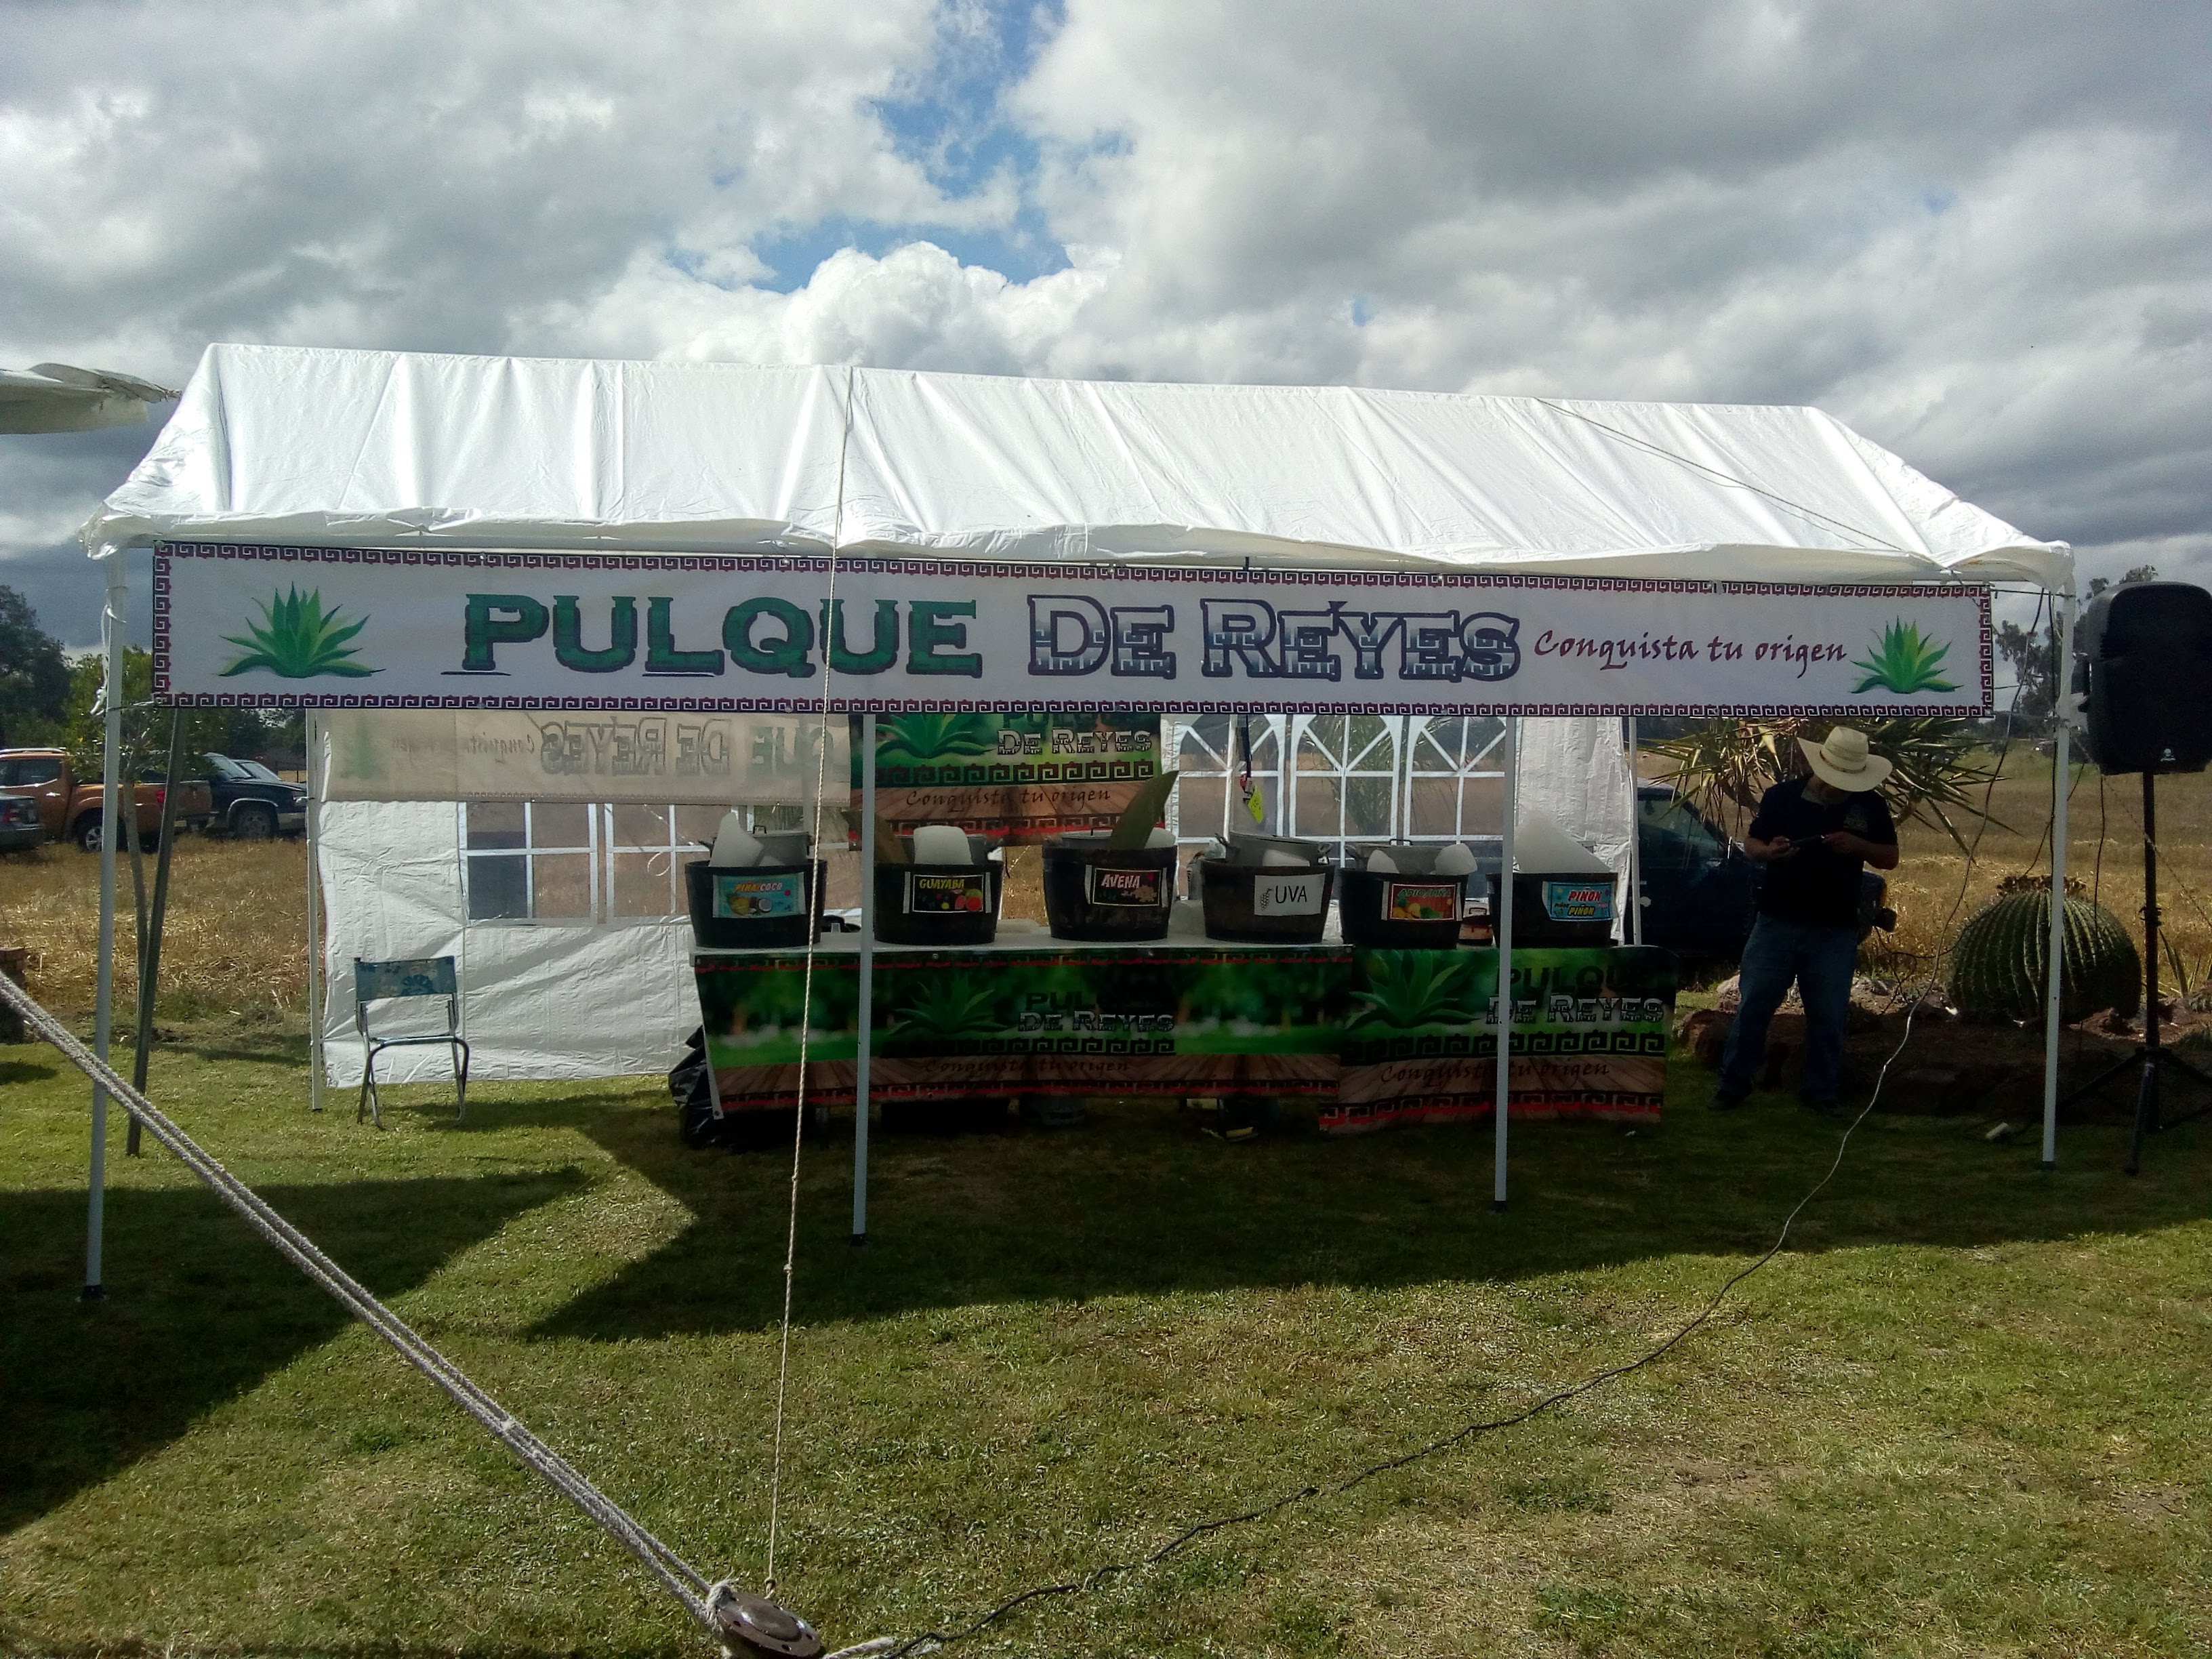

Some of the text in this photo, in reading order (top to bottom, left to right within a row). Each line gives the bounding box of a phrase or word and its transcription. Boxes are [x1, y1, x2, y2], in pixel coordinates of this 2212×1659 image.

[462, 594, 983, 678] PULQUE
[1027, 594, 1176, 680] DE
[1534, 630, 1847, 678] Conquista tu origen
[997, 726, 1153, 755] DE REYES
[1019, 788, 1044, 804] tu
[918, 878, 965, 889] GUAYABA
[1101, 874, 1141, 888] AVENA
[1275, 885, 1307, 904] UVA
[1548, 992, 1664, 1023] REYES
[1018, 1010, 1174, 1032] DE REYES
[1381, 1062, 1496, 1088] Conquist
